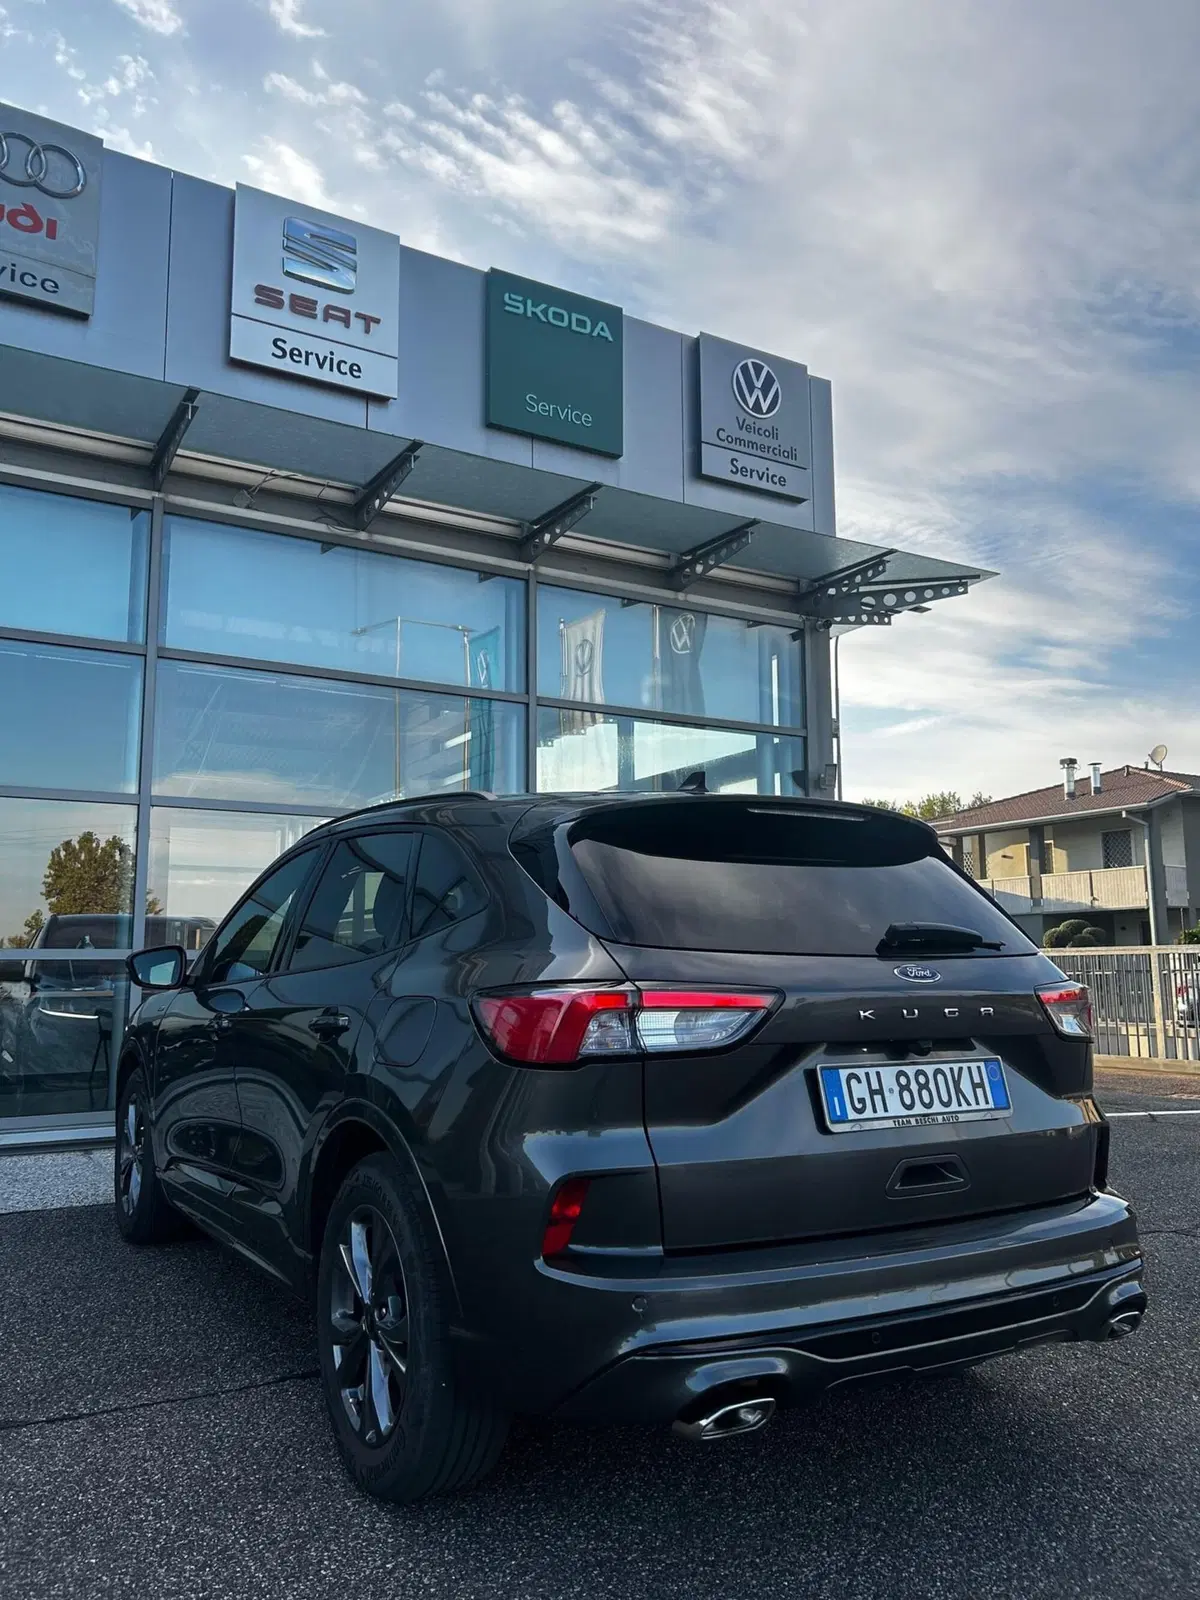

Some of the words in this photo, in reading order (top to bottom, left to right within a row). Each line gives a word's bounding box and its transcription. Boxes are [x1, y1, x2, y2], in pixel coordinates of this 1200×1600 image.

[254, 284, 381, 335] SEAT
[271, 337, 363, 379] Service
[525, 393, 592, 428] Service
[716, 428, 798, 461] Commerciali
[735, 416, 779, 441] Veicoli
[730, 458, 787, 487] Service
[892, 1118, 912, 1127] TEAM
[915, 1117, 939, 1125] BESCHI
[942, 1115, 960, 1123] AUTO
